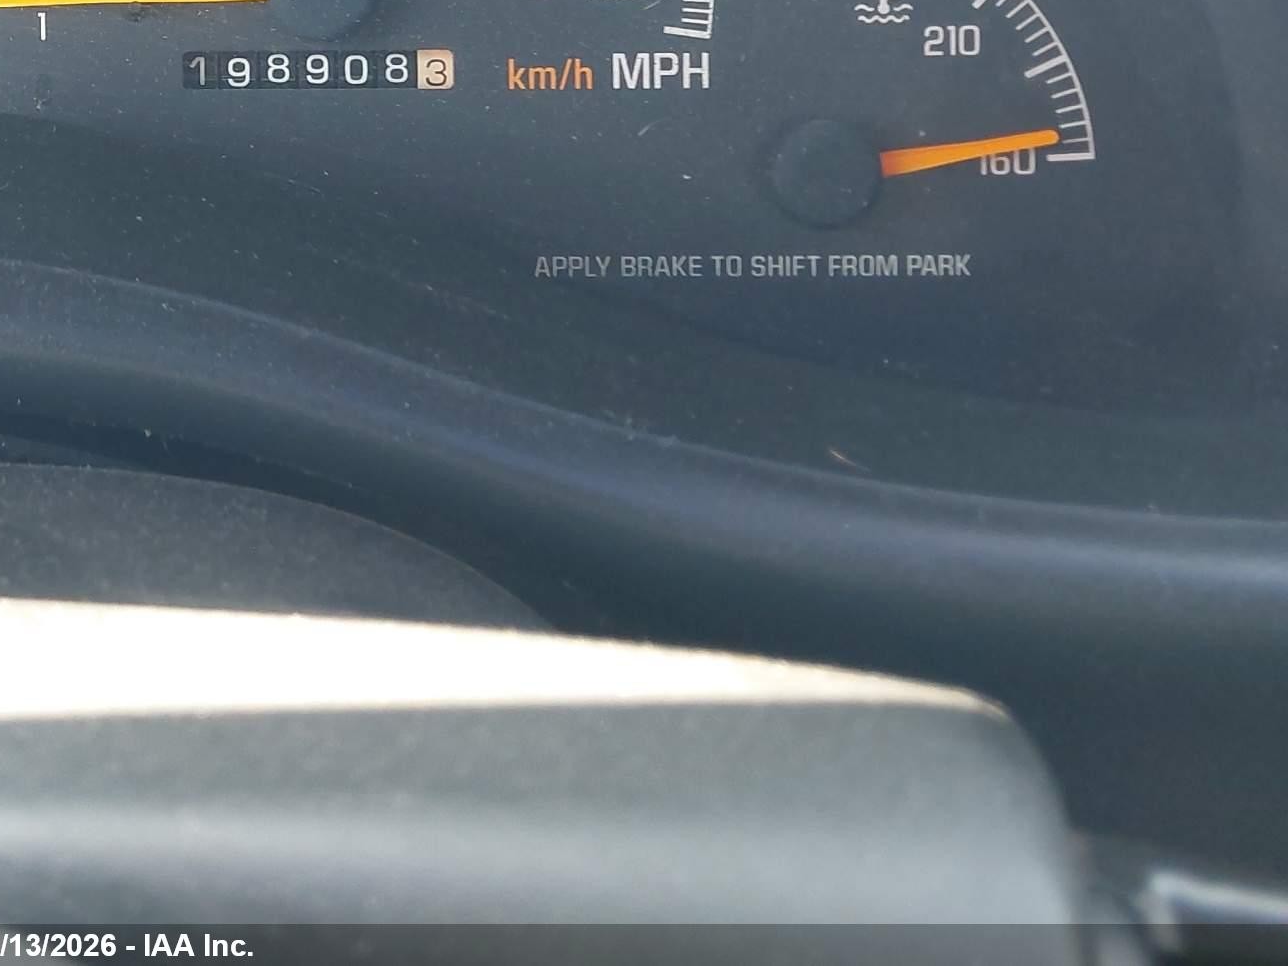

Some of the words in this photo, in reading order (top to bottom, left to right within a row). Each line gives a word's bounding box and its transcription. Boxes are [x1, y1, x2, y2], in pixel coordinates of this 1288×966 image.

[37, 12, 46, 41] 1
[924, 25, 980, 56] 210
[508, 58, 593, 91] km/h
[612, 52, 709, 89] MPH
[979, 148, 1034, 175] 160
[535, 255, 611, 277] APPLY
[621, 255, 702, 277] BRAKE
[711, 255, 742, 277] TO
[751, 255, 820, 277] SHIFT
[828, 254, 898, 277] FROM
[907, 254, 970, 276] PARK
